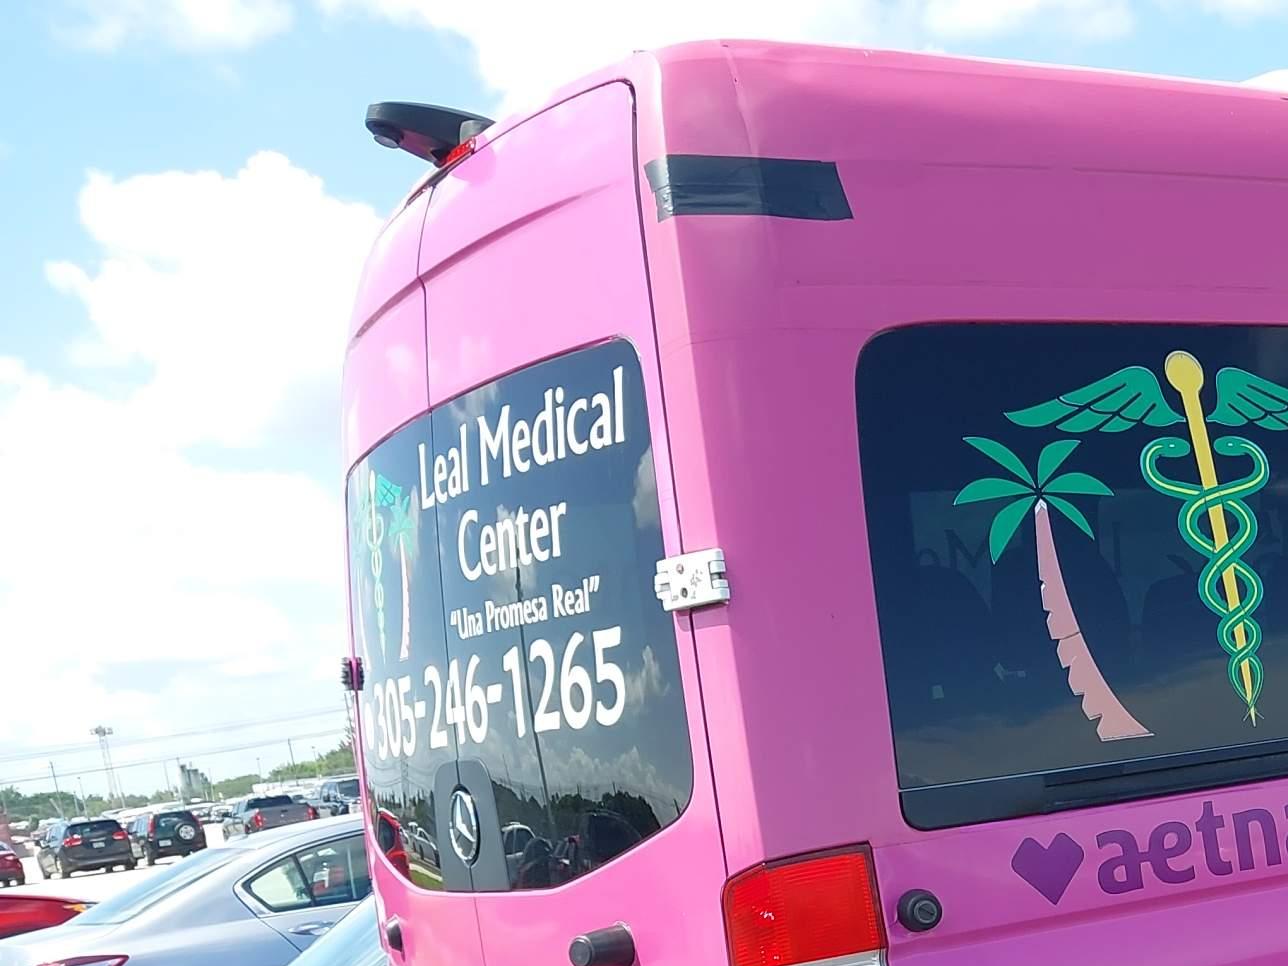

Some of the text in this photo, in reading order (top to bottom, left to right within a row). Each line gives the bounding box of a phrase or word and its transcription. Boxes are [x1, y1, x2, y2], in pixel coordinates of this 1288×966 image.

[418, 365, 625, 510] Leal Medical
[458, 501, 567, 582] Center
[485, 594, 548, 635] Promesa
[373, 625, 626, 761] 305-246-1265
